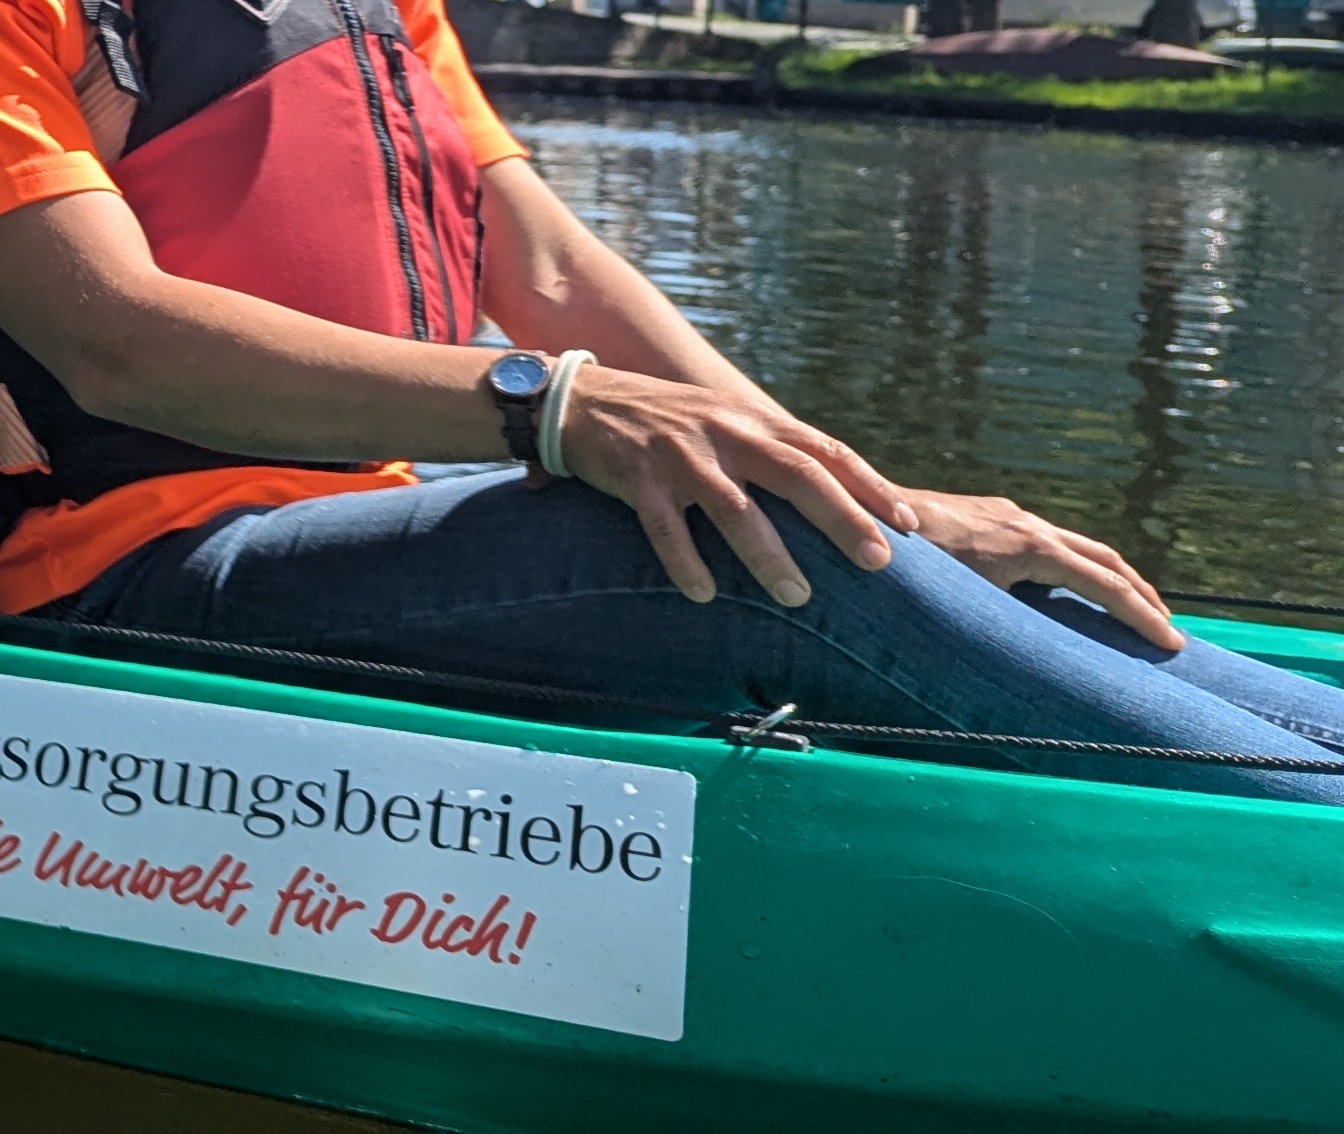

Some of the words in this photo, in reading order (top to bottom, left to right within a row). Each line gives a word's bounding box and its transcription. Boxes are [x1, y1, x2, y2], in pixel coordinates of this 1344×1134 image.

[34, 831, 253, 927] Umwelt,
[269, 866, 365, 936] für
[370, 891, 538, 965] Dich!
